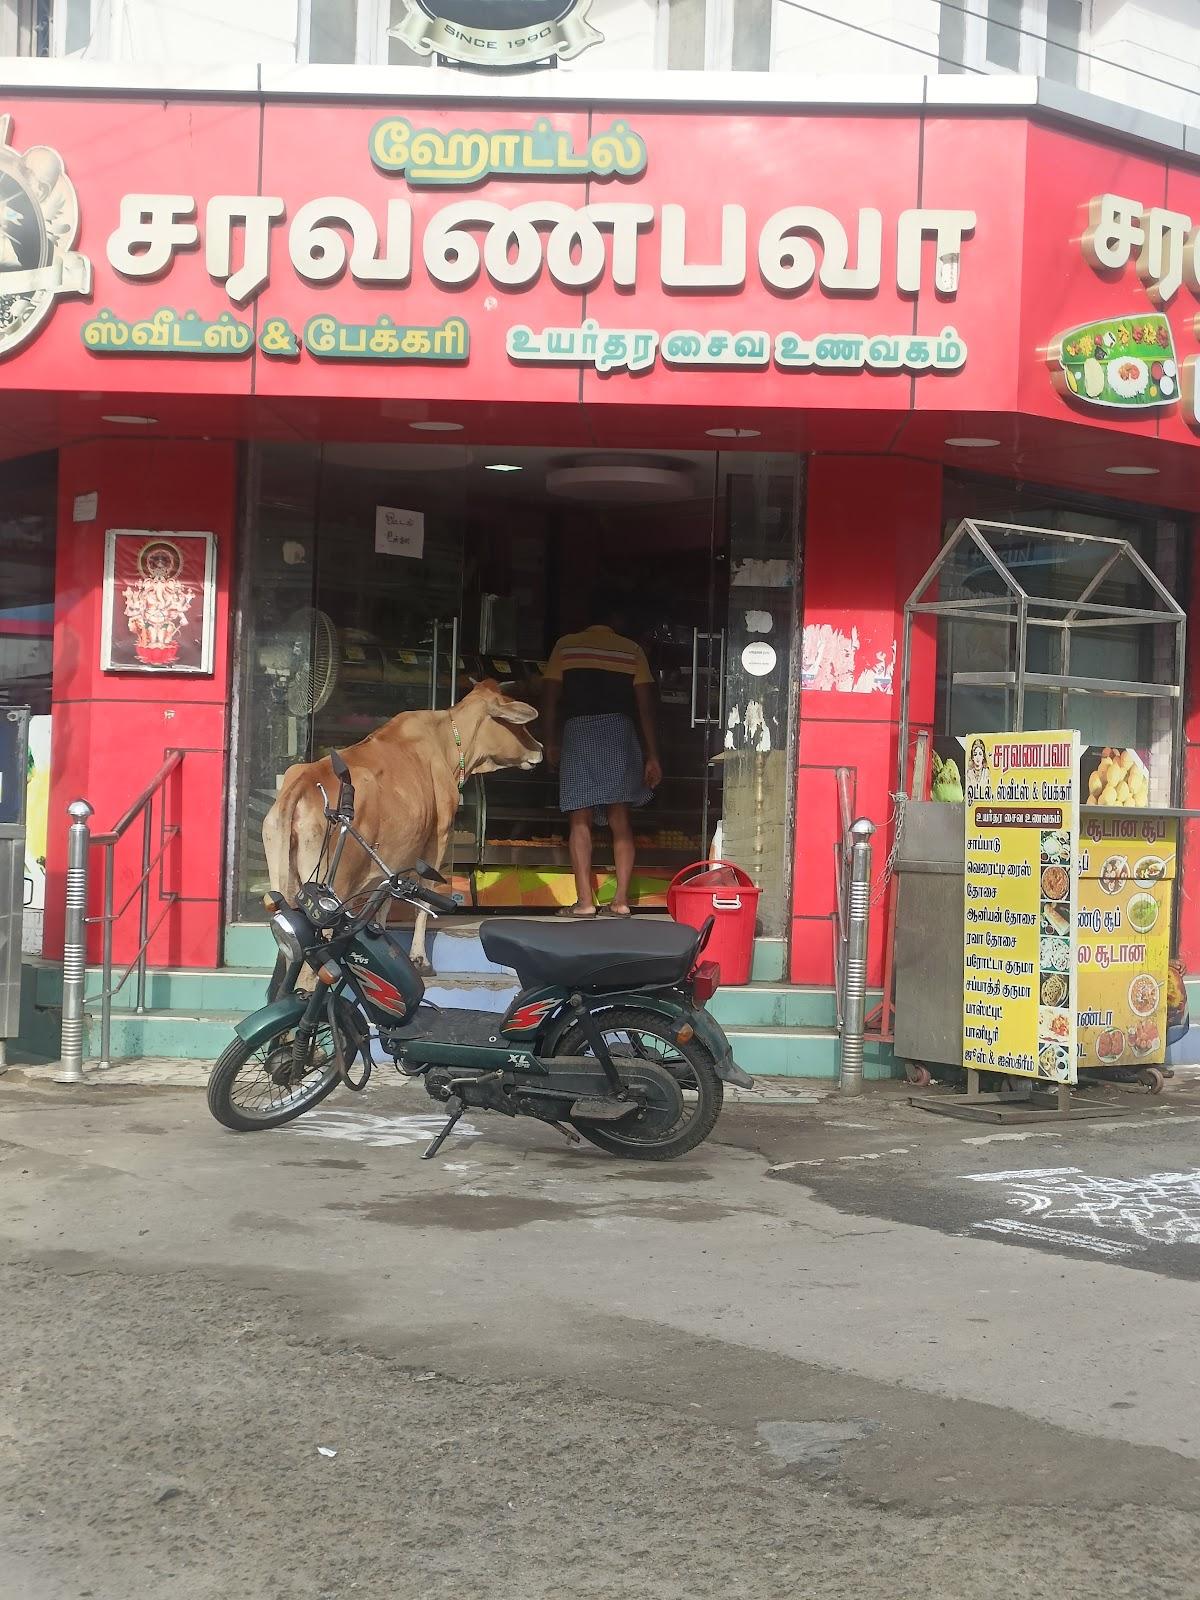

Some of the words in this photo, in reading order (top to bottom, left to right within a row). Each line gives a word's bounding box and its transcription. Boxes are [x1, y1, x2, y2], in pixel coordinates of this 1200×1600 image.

[443, 24, 498, 49] SINCE
[508, 26, 552, 49] 1990
[373, 120, 642, 179] ஹோட்டல்
[106, 193, 977, 301] சரவணபவா
[1093, 193, 1200, 302] சர
[84, 309, 250, 349] ஸ்வீட்ஸ்
[262, 320, 293, 351] &
[307, 318, 465, 354] பேக்கரி
[511, 322, 653, 365] உயர்தர
[666, 334, 765, 358] சைவ
[780, 331, 961, 363] உணவகம்
[993, 744, 1072, 773] சரவணபவா
[1032, 781, 1039, 800] &
[975, 809, 1003, 825] உயர்தர
[1004, 813, 1024, 824] சைவ
[1025, 810, 1062, 825] உணவகம்
[966, 834, 1001, 853] சாப்பாடு
[1007, 860, 1032, 877] ரைஸ்
[966, 883, 998, 899] தோசை
[966, 906, 1002, 923] ஆனியன்
[1004, 909, 1037, 926] தோசை
[1077, 906, 1101, 933] ண்டு
[966, 932, 984, 946] ரவா
[985, 931, 1017, 948] தோசை
[354, 955, 369, 965] TVS
[966, 953, 1003, 970] பரோட்டா
[1005, 960, 1034, 976] குருமா
[966, 975, 1001, 996] சப்பாத்தி
[1002, 984, 1031, 1000] குருமா
[507, 1054, 530, 1064] XL
[988, 1050, 995, 1065] &
